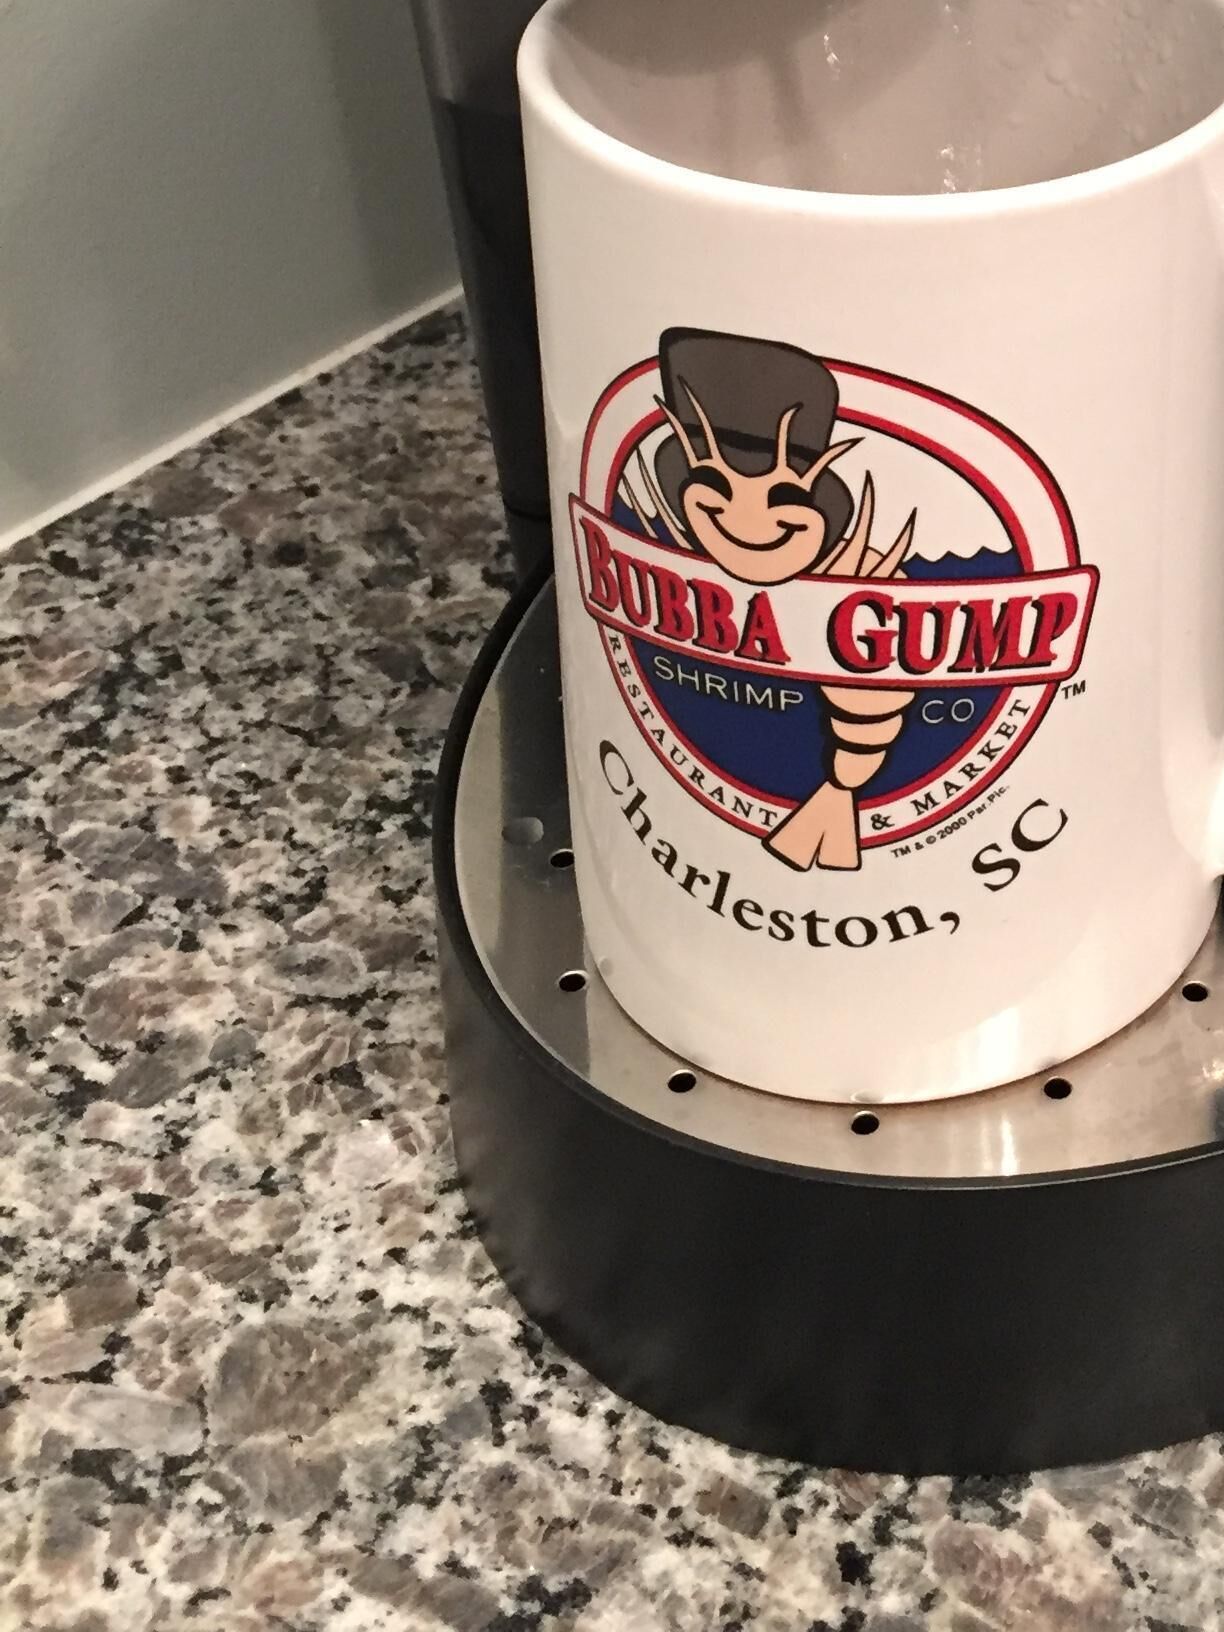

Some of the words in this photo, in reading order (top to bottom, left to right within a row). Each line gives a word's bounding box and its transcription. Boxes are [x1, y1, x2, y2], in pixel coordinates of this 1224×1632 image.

[580, 516, 792, 666] BUBBA
[826, 589, 1080, 674] GUMP
[608, 633, 778, 828] RESTAURANT
[869, 811, 896, 832] &
[910, 697, 1031, 817] MARKET
[653, 655, 804, 712] SHRIMP
[920, 696, 976, 726] CO
[1060, 679, 1086, 700] TM
[599, 738, 961, 949] Charleston,
[971, 797, 1069, 893] SC
[936, 815, 968, 840] 2000
